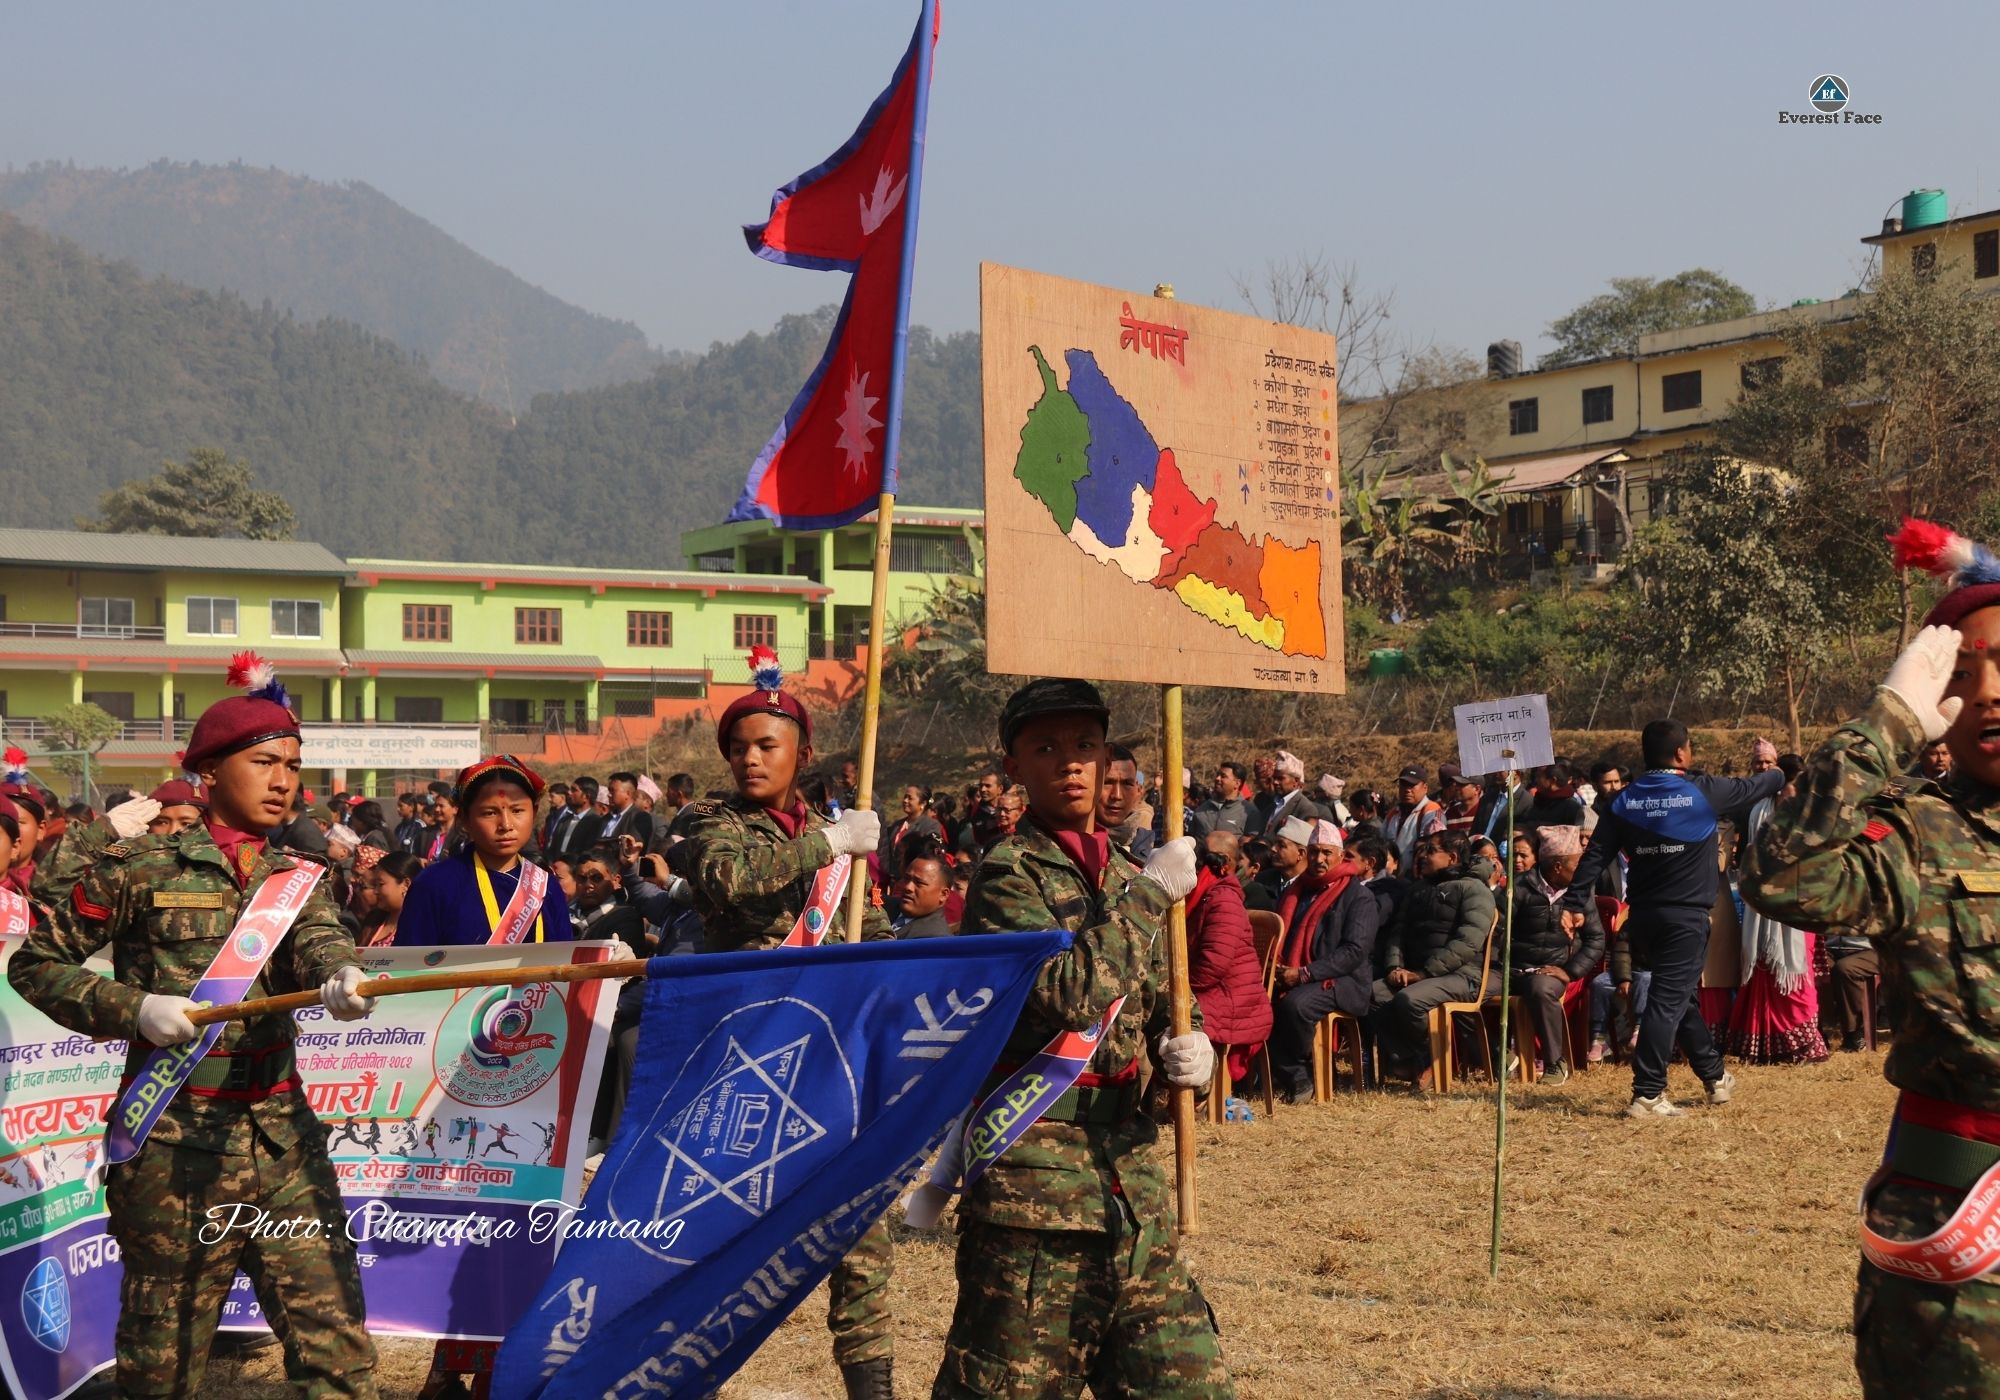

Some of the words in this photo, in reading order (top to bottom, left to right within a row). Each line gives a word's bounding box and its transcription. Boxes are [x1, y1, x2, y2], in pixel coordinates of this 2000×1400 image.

[1119, 301, 1189, 366] नेपाल
[1292, 379, 1310, 398] प्रदेश
[1292, 400, 1311, 421] प्रदेश
[1302, 421, 1321, 439] प्रदेश
[1303, 441, 1322, 459] प्रदेश
[1238, 463, 1247, 480] N
[1305, 462, 1324, 481] प्रदेश
[1304, 483, 1322, 499] प्रदेश
[1312, 503, 1330, 520] प्रदेश
[1466, 712, 1503, 725] चन्द्रोदय
[419, 758, 459, 766] CAMPUS
[697, 804, 714, 814] NCC
